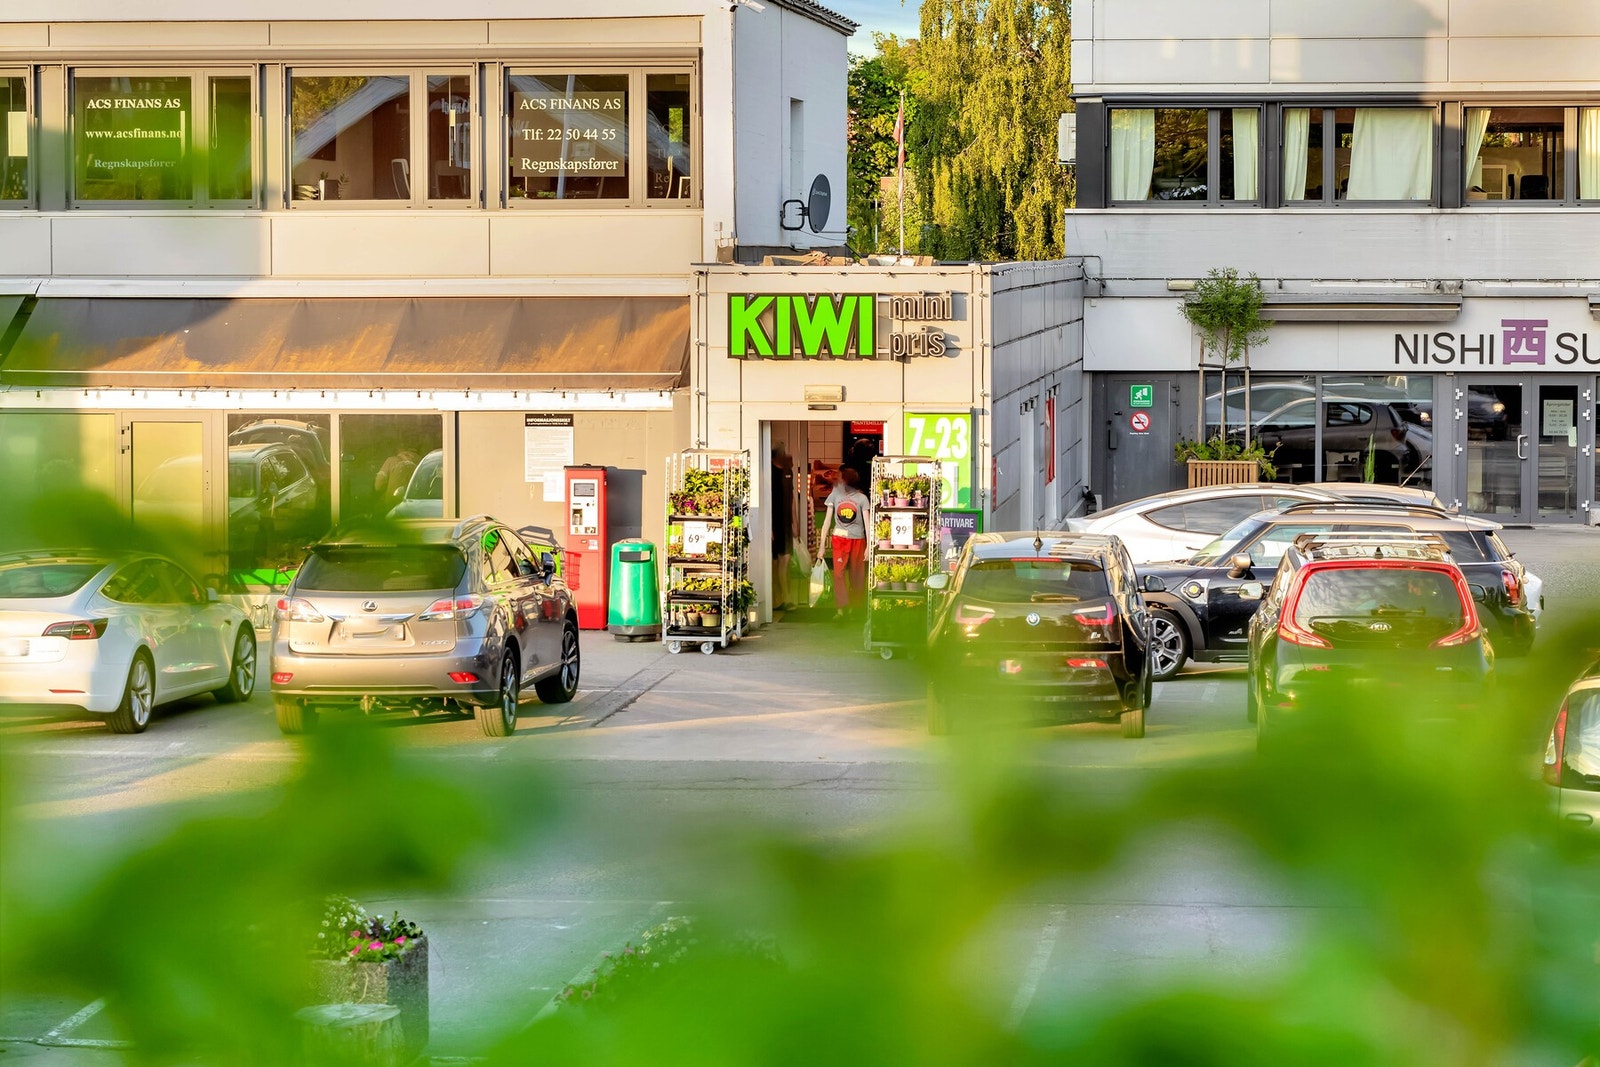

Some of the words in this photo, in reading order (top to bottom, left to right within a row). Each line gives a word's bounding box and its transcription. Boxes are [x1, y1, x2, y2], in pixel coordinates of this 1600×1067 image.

[87, 98, 112, 109] ACS
[114, 98, 162, 109] FINANS
[164, 98, 181, 109] AS
[519, 98, 547, 110] ACS
[550, 98, 600, 110] FINANS
[603, 98, 621, 110] AS
[85, 128, 182, 139] www.acsfinans.no
[522, 129, 544, 141] Tlf:
[547, 129, 562, 140] 22
[566, 129, 580, 140] 50
[583, 129, 598, 140] 44
[601, 129, 616, 140] 55
[94, 158, 176, 170] Regnskapsfører
[521, 157, 619, 173] Regnskapsfører
[728, 293, 877, 359] KIWI
[889, 290, 952, 321] mini
[888, 326, 946, 361] pris
[1394, 332, 1494, 365] NISHI
[1501, 319, 1548, 365] 西
[908, 417, 968, 459] 7-23
[941, 517, 974, 528] ARTIVARE
[1373, 623, 1390, 631] KIA
